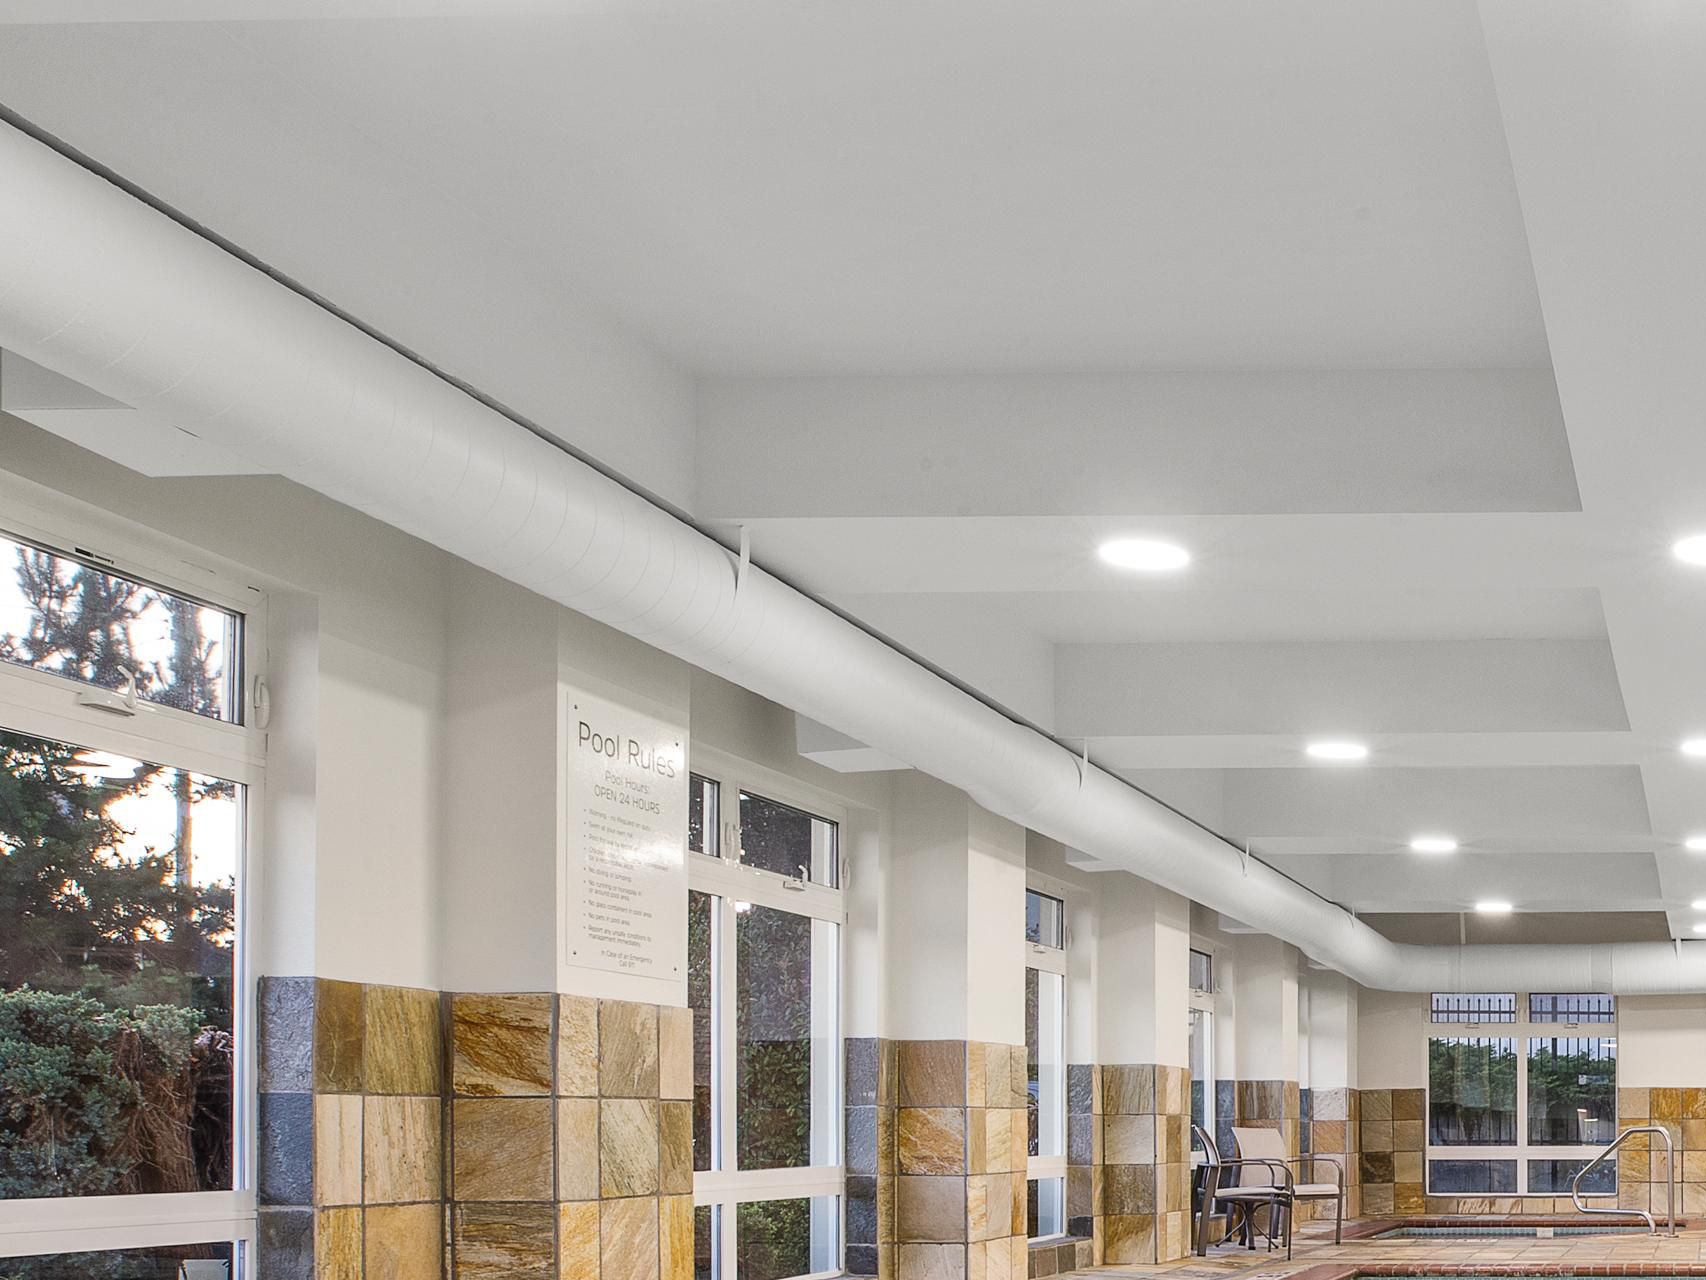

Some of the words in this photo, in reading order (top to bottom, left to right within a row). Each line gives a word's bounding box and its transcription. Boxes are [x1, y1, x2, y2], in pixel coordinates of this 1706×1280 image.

[579, 721, 620, 760] Pool
[628, 739, 675, 778] Rules
[605, 770, 623, 786] Pool
[594, 784, 617, 802] OPEN
[619, 793, 630, 805] 24
[632, 797, 660, 815] HOURS
